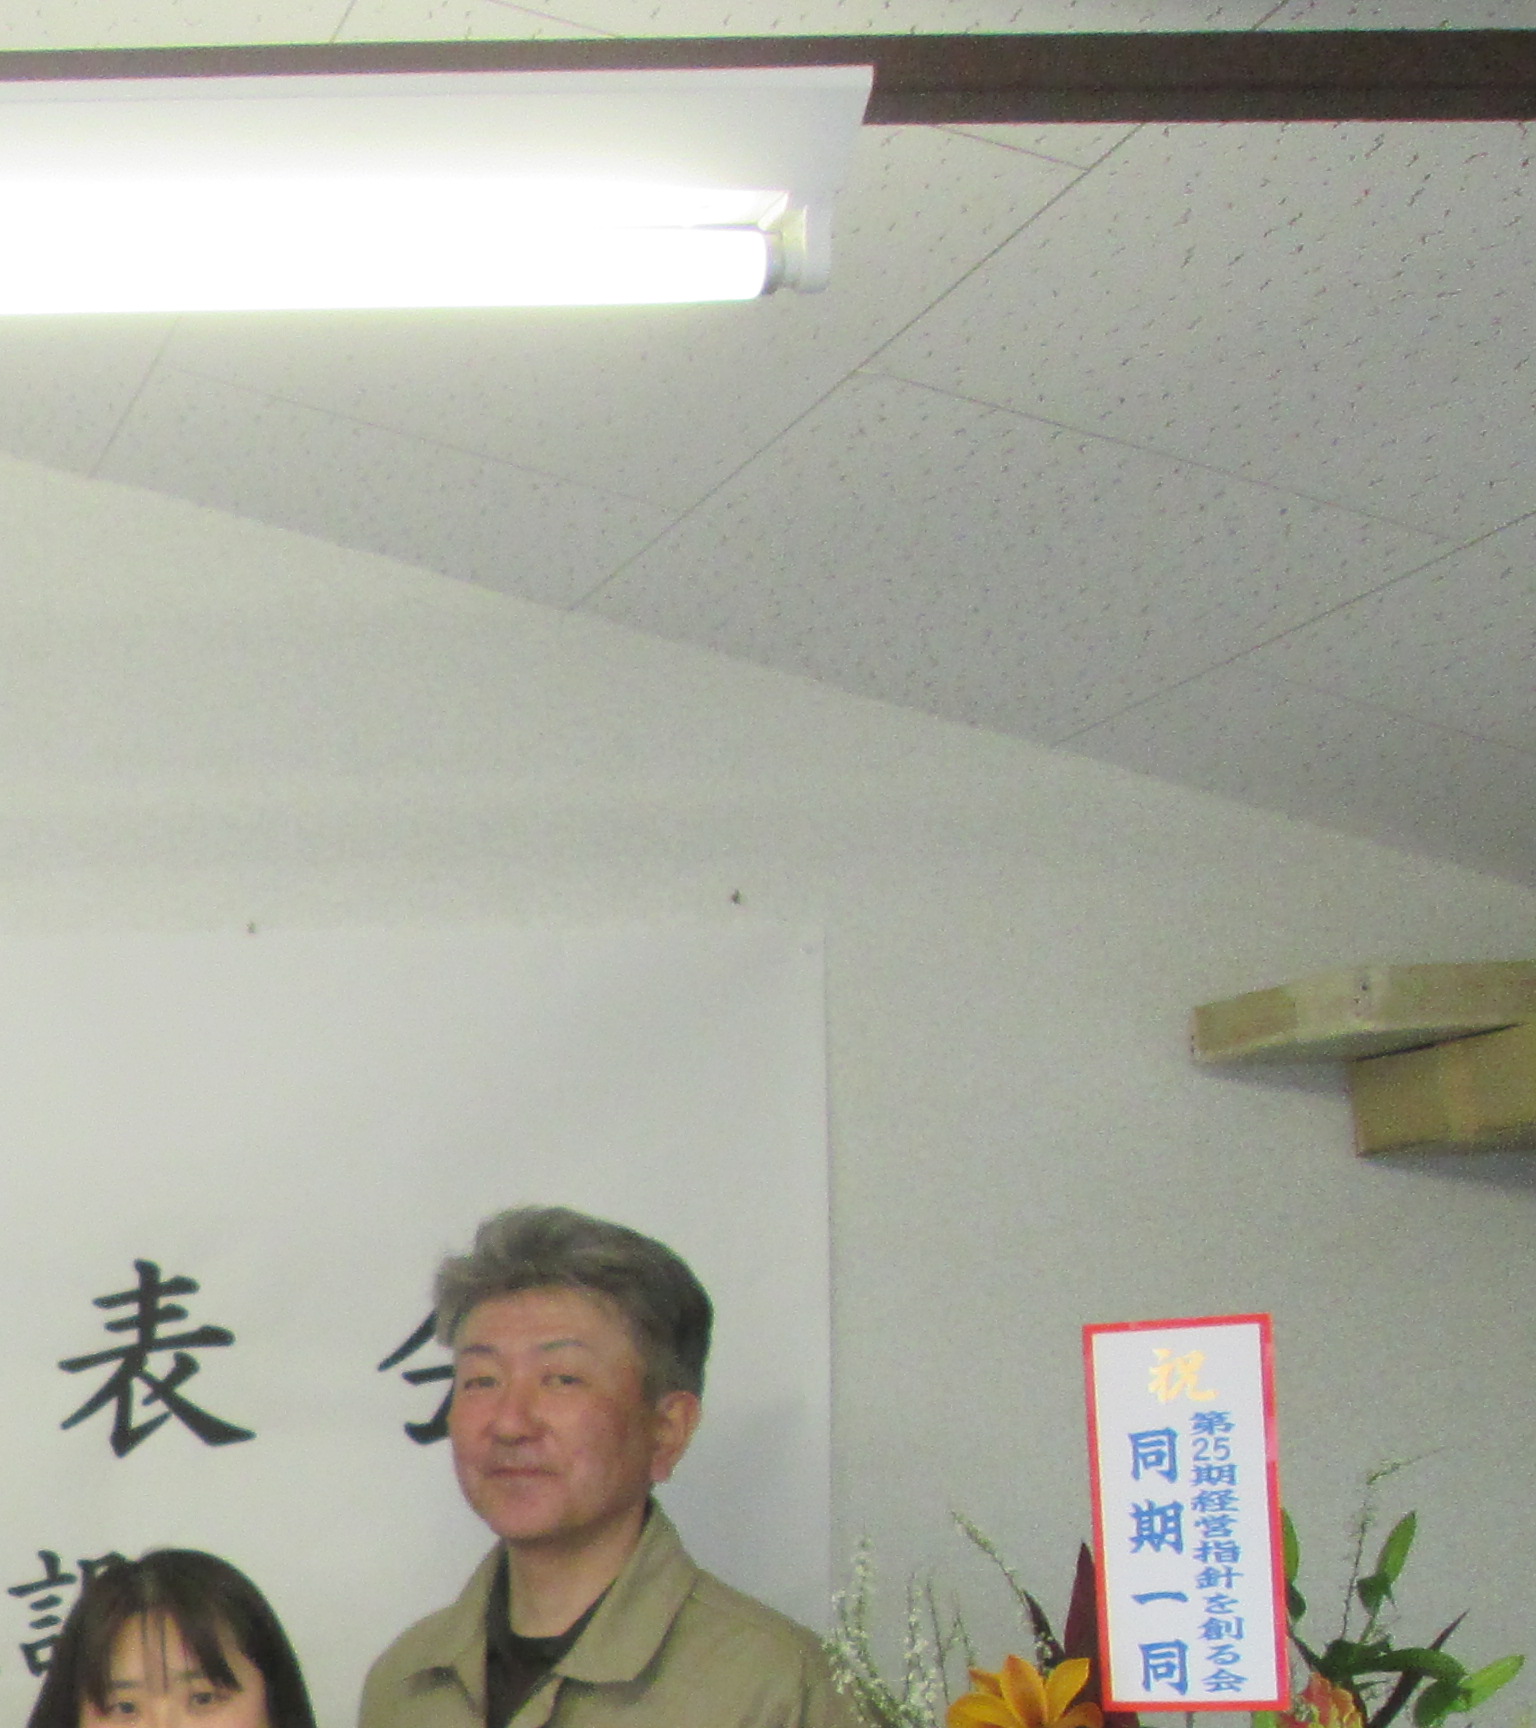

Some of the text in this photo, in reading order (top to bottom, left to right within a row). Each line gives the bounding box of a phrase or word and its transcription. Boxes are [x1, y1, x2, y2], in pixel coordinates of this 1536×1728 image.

[1147, 1347, 1220, 1402] 祝
[1127, 1426, 1191, 1696] 同期一同
[1187, 1409, 1248, 1694] 第25期経営指針を創る会
